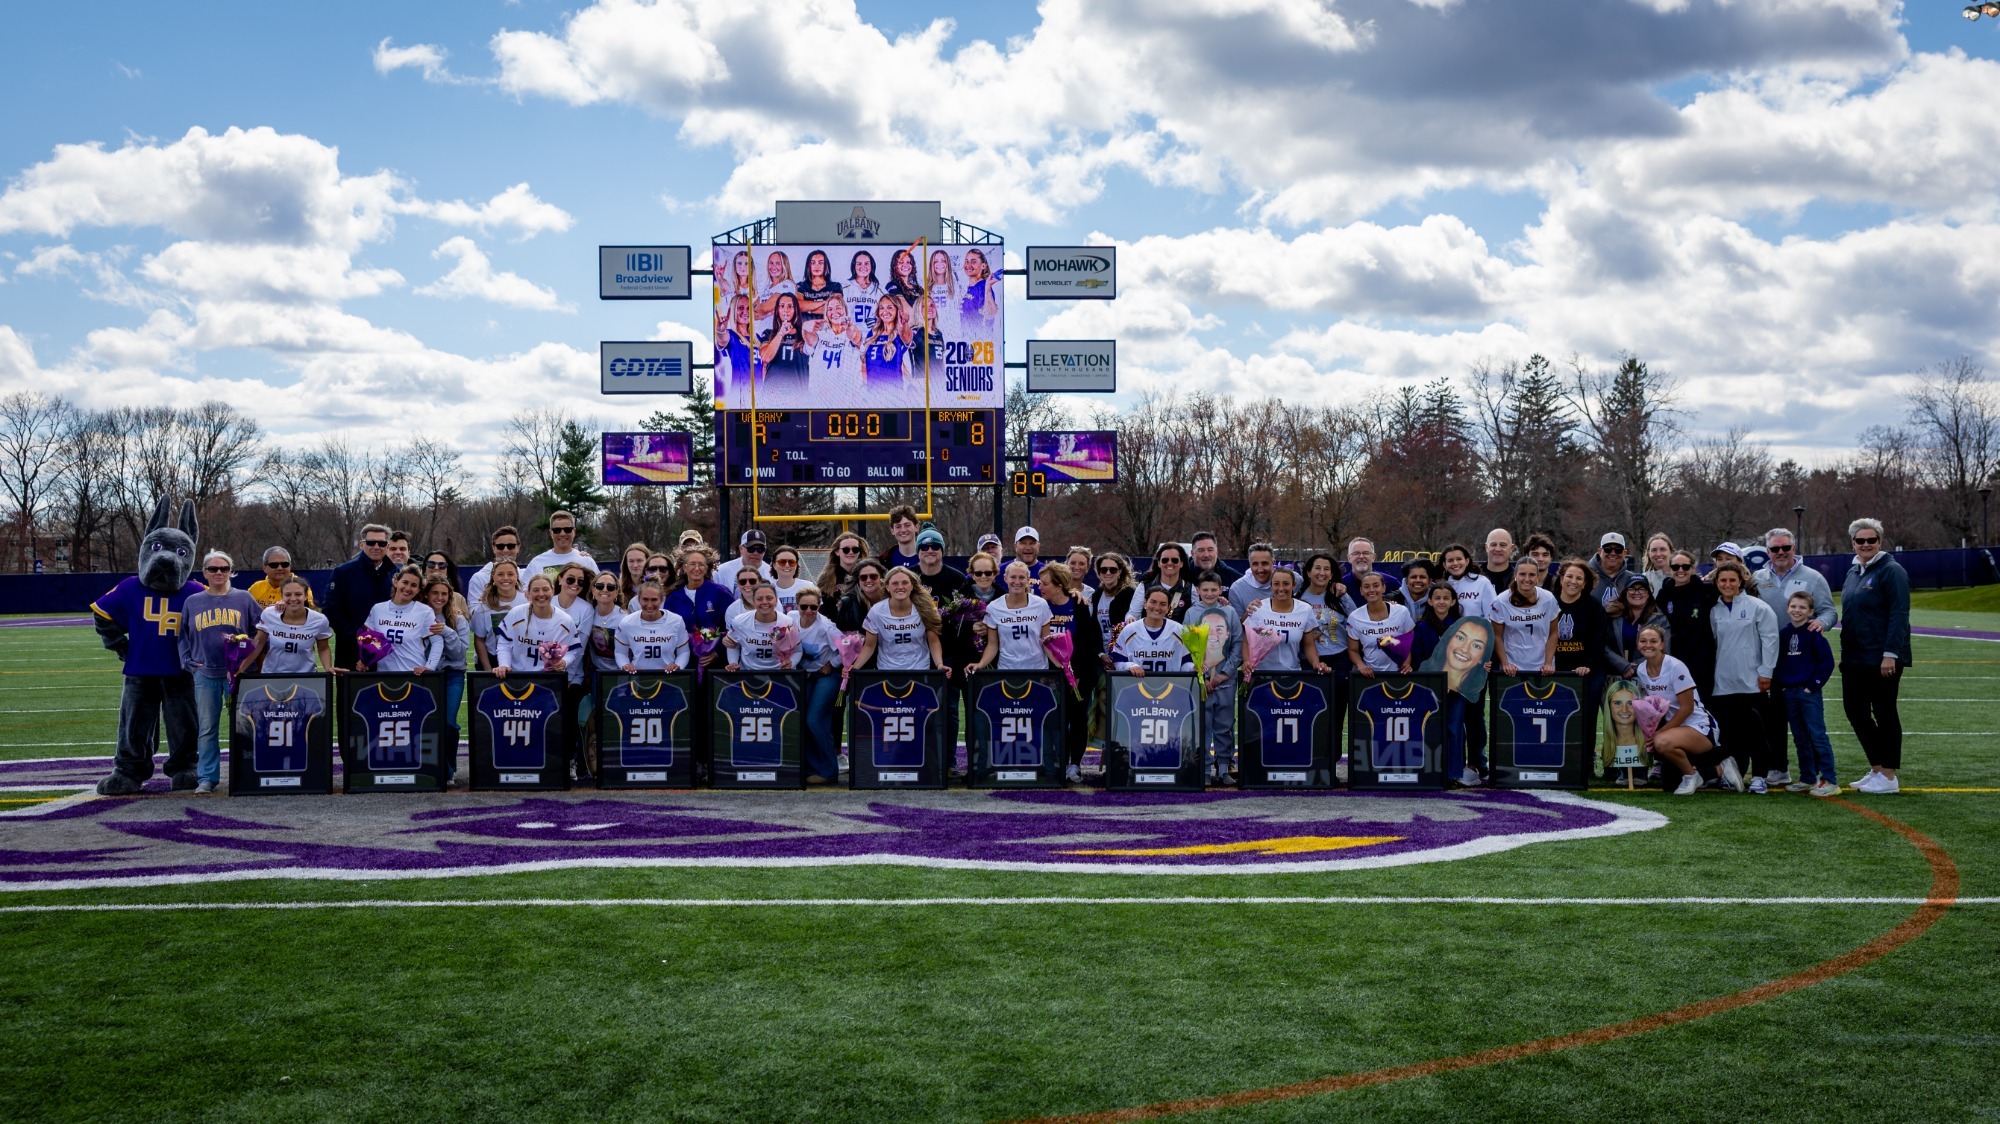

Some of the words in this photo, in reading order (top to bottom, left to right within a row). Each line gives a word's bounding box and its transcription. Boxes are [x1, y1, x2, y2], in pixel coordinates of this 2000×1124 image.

[836, 218, 880, 236] UALBANY
[1034, 259, 1098, 272] MOHAWK
[616, 274, 674, 284] Broadview
[870, 346, 878, 360] 3
[1034, 354, 1110, 366] ELEVATION
[610, 358, 682, 376] CDTA
[946, 366, 994, 392] SENIORS
[741, 412, 783, 423] UALBANY
[938, 411, 974, 422] BRYANT
[972, 422, 984, 445] 8
[772, 450, 779, 462] 2
[786, 451, 808, 460] T.O.L.
[942, 448, 948, 460] 0
[744, 467, 776, 478] DOWN
[821, 466, 834, 478] TO
[836, 466, 850, 478] GO
[868, 466, 889, 477] BALL
[892, 466, 904, 477] ON
[949, 466, 972, 477] QTR.
[982, 464, 990, 478] 4
[194, 608, 242, 632] UALBANY
[1000, 616, 1038, 624] UALBANY
[1264, 618, 1302, 628] UALBANY
[1510, 612, 1546, 622] UALBANY
[378, 620, 418, 628] UALBANY
[884, 622, 920, 631] UALBANY
[1525, 624, 1534, 636] 7
[272, 630, 314, 640] UALBANY
[386, 628, 404, 644] 55
[1012, 624, 1028, 640] 24
[1362, 626, 1400, 636] UALBANY
[894, 633, 912, 644] 25
[284, 642, 298, 654] 91
[644, 646, 662, 658] 30
[1134, 650, 1175, 658] UALBANY
[377, 710, 412, 718] UALBANY
[493, 708, 542, 719] UALBANY
[1130, 706, 1179, 718] UALBANY
[1522, 707, 1557, 716] UALBANY
[268, 720, 293, 747] 91
[378, 720, 411, 748] 55
[502, 720, 532, 746] 44
[630, 718, 662, 744] 30
[740, 716, 773, 742] 26
[883, 716, 915, 742] 25
[1001, 717, 1033, 743] 24
[1140, 718, 1169, 745] 20
[1276, 717, 1299, 744] 17
[1386, 716, 1410, 742] 10
[1532, 717, 1547, 744] 7
